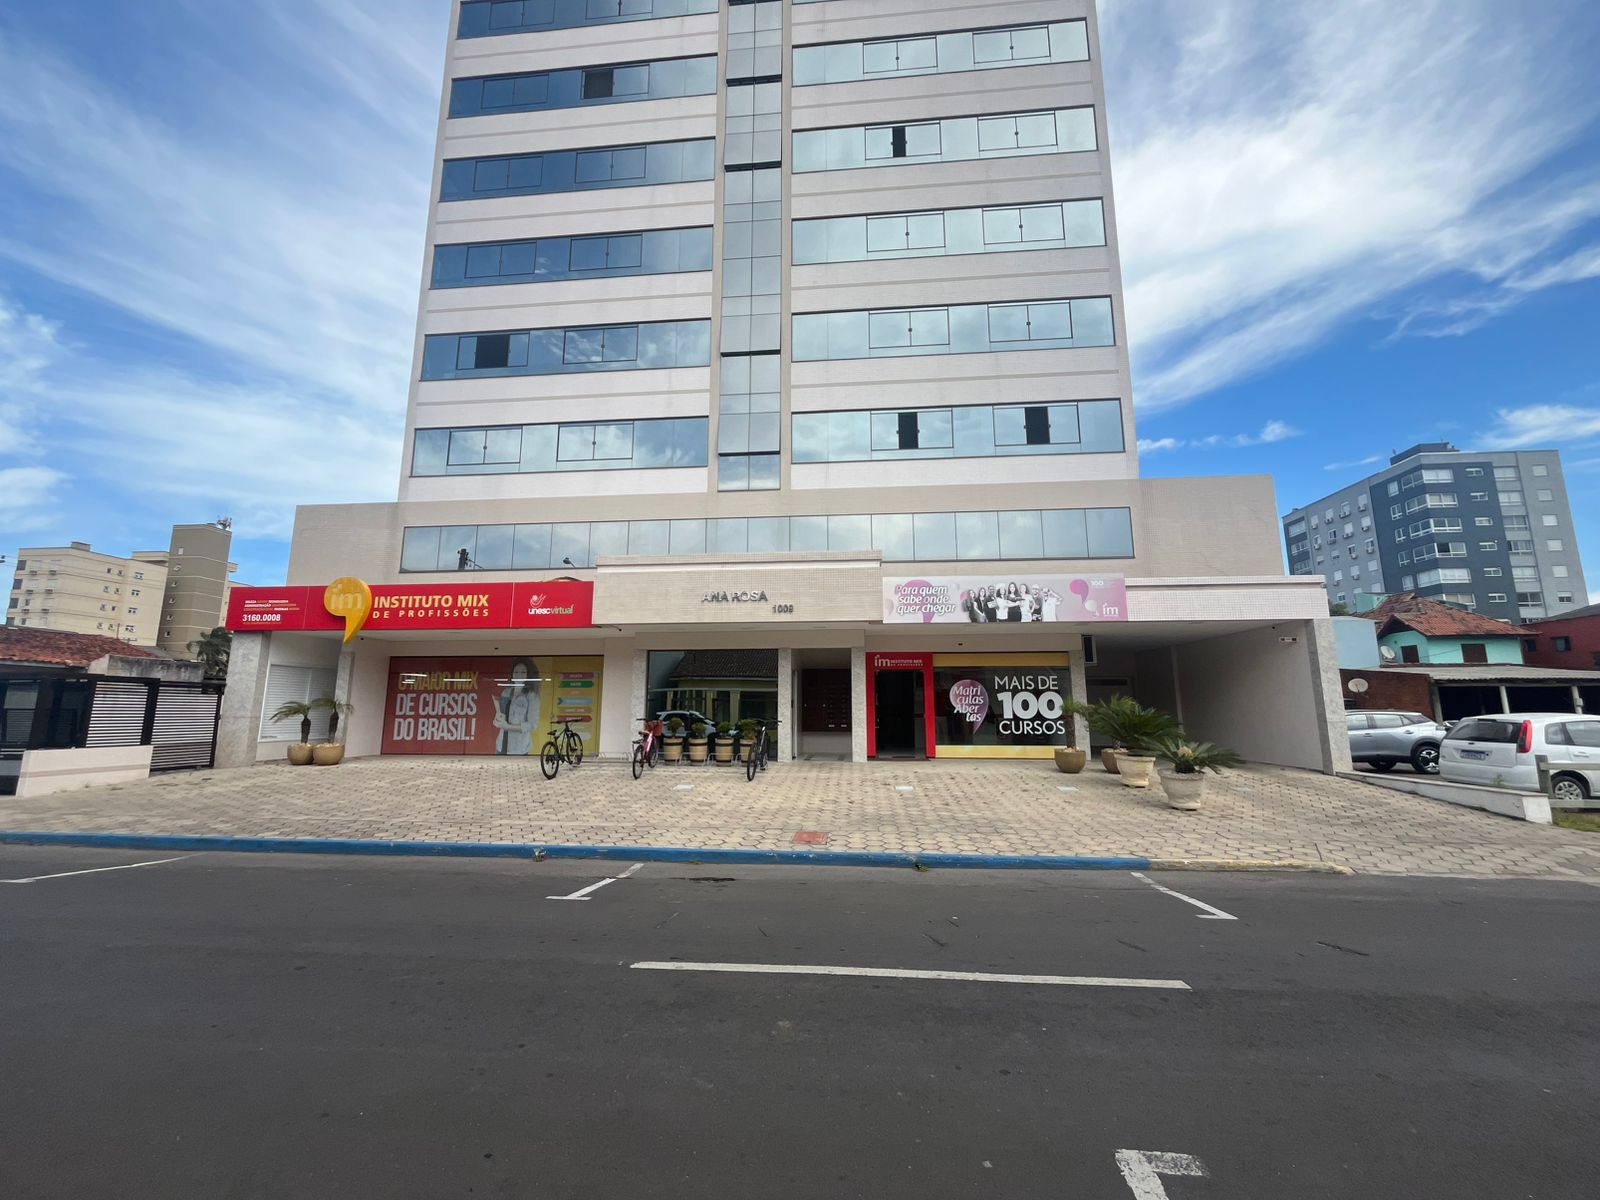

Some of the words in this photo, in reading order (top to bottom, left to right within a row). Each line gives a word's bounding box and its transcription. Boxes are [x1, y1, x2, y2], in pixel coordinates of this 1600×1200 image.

[702, 591, 729, 602] ANA
[732, 590, 768, 602] ROSA
[895, 584, 918, 596] Para
[920, 586, 947, 597] quem
[373, 595, 453, 608] INSTITUTO
[457, 594, 489, 607] MIX
[899, 595, 922, 604] sabe
[923, 594, 949, 603] onde
[372, 611, 391, 619] DE
[399, 608, 489, 618] PROFISSÕES
[897, 604, 920, 616] quer
[922, 603, 956, 616] chegar
[242, 614, 281, 622] 3160.0008
[994, 676, 1035, 690] MAIS
[1038, 676, 1059, 690] DE
[952, 685, 981, 695] Matri
[395, 693, 416, 715] DE
[419, 693, 478, 715] CURSOS
[957, 695, 984, 704] culas
[997, 691, 1064, 719] 100
[954, 703, 980, 714] Aber
[966, 711, 981, 722] tas
[393, 718, 414, 740] DO
[417, 718, 476, 740] BRASIL!
[999, 720, 1066, 734] CURSOS
